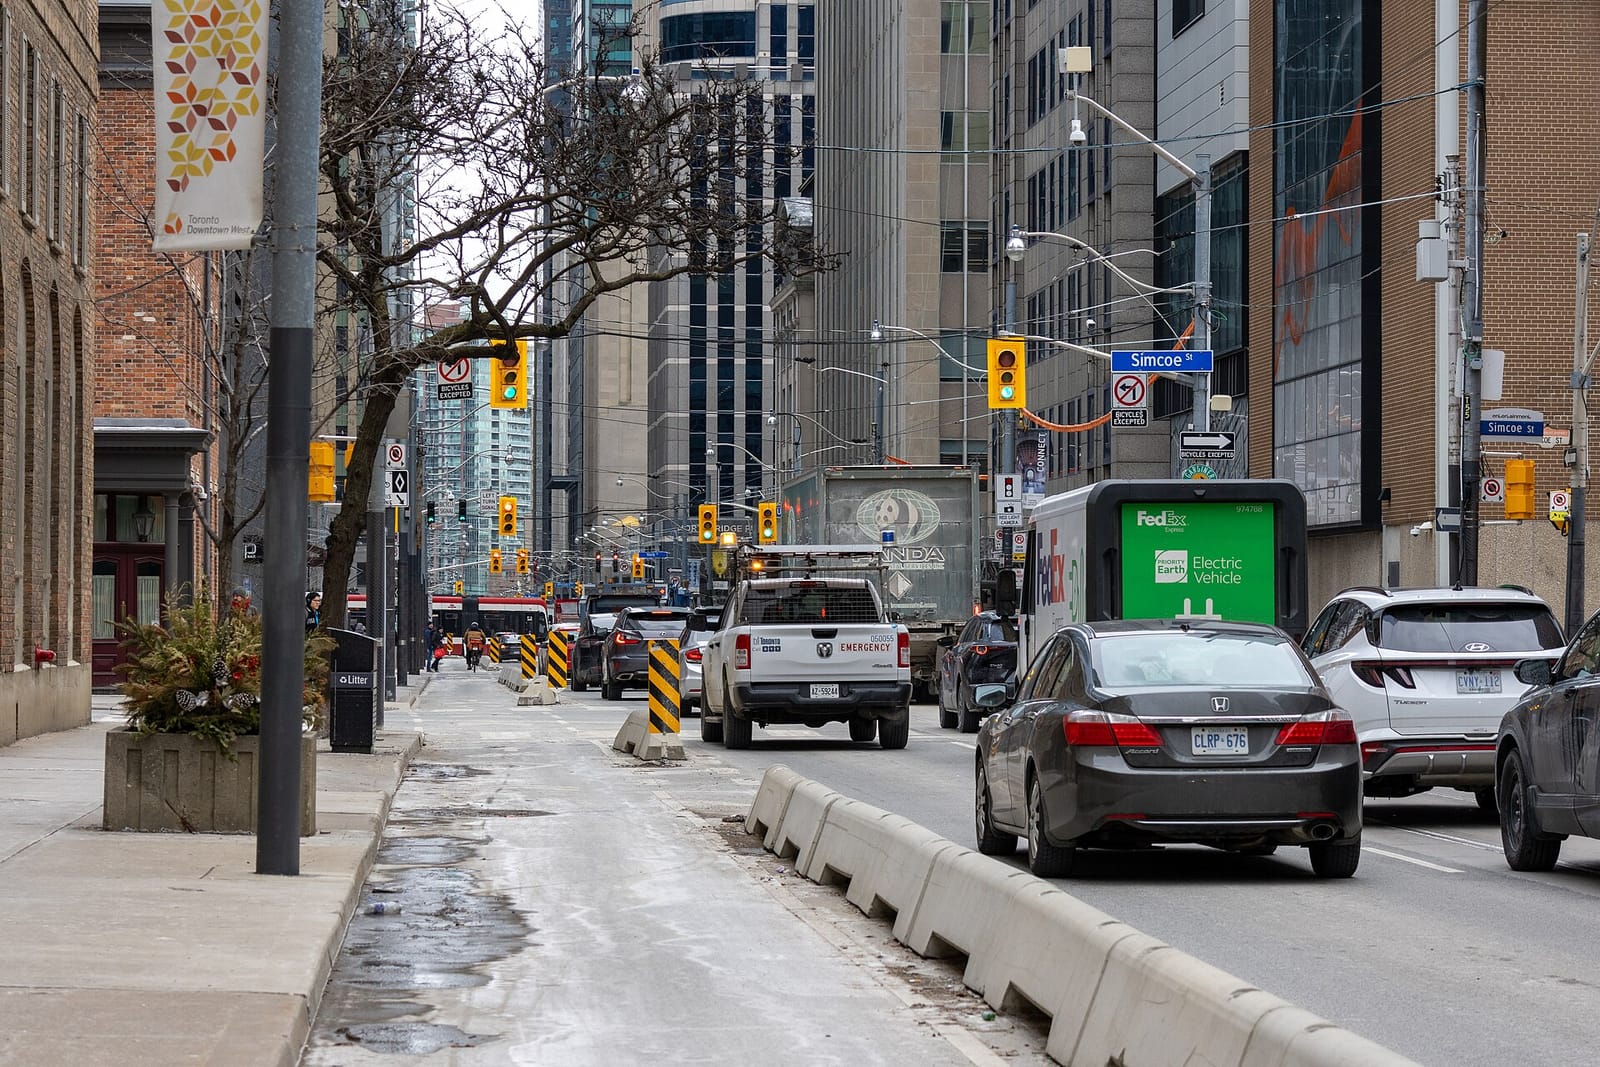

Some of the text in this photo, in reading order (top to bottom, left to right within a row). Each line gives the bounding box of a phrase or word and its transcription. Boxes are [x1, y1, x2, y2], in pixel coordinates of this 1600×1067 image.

[188, 214, 219, 224] Toronto
[187, 225, 229, 234] Downtown
[1131, 353, 1193, 367] Simcoe St
[441, 384, 469, 392] BICYCLES
[439, 391, 471, 399] EXCEPTED
[1488, 422, 1522, 433] Simcoe
[1526, 425, 1535, 433] St
[1036, 432, 1046, 472] CONNECT
[1137, 510, 1187, 526] FedEx
[1037, 528, 1065, 606] FedEx
[1193, 556, 1243, 570] Electric
[1158, 565, 1185, 574] Earth
[1193, 571, 1242, 584] Vehicle
[871, 635, 895, 643] 050055
[840, 643, 890, 652] EMERGENCY
[347, 674, 368, 685] Litter
[1125, 747, 1159, 755] Accord
